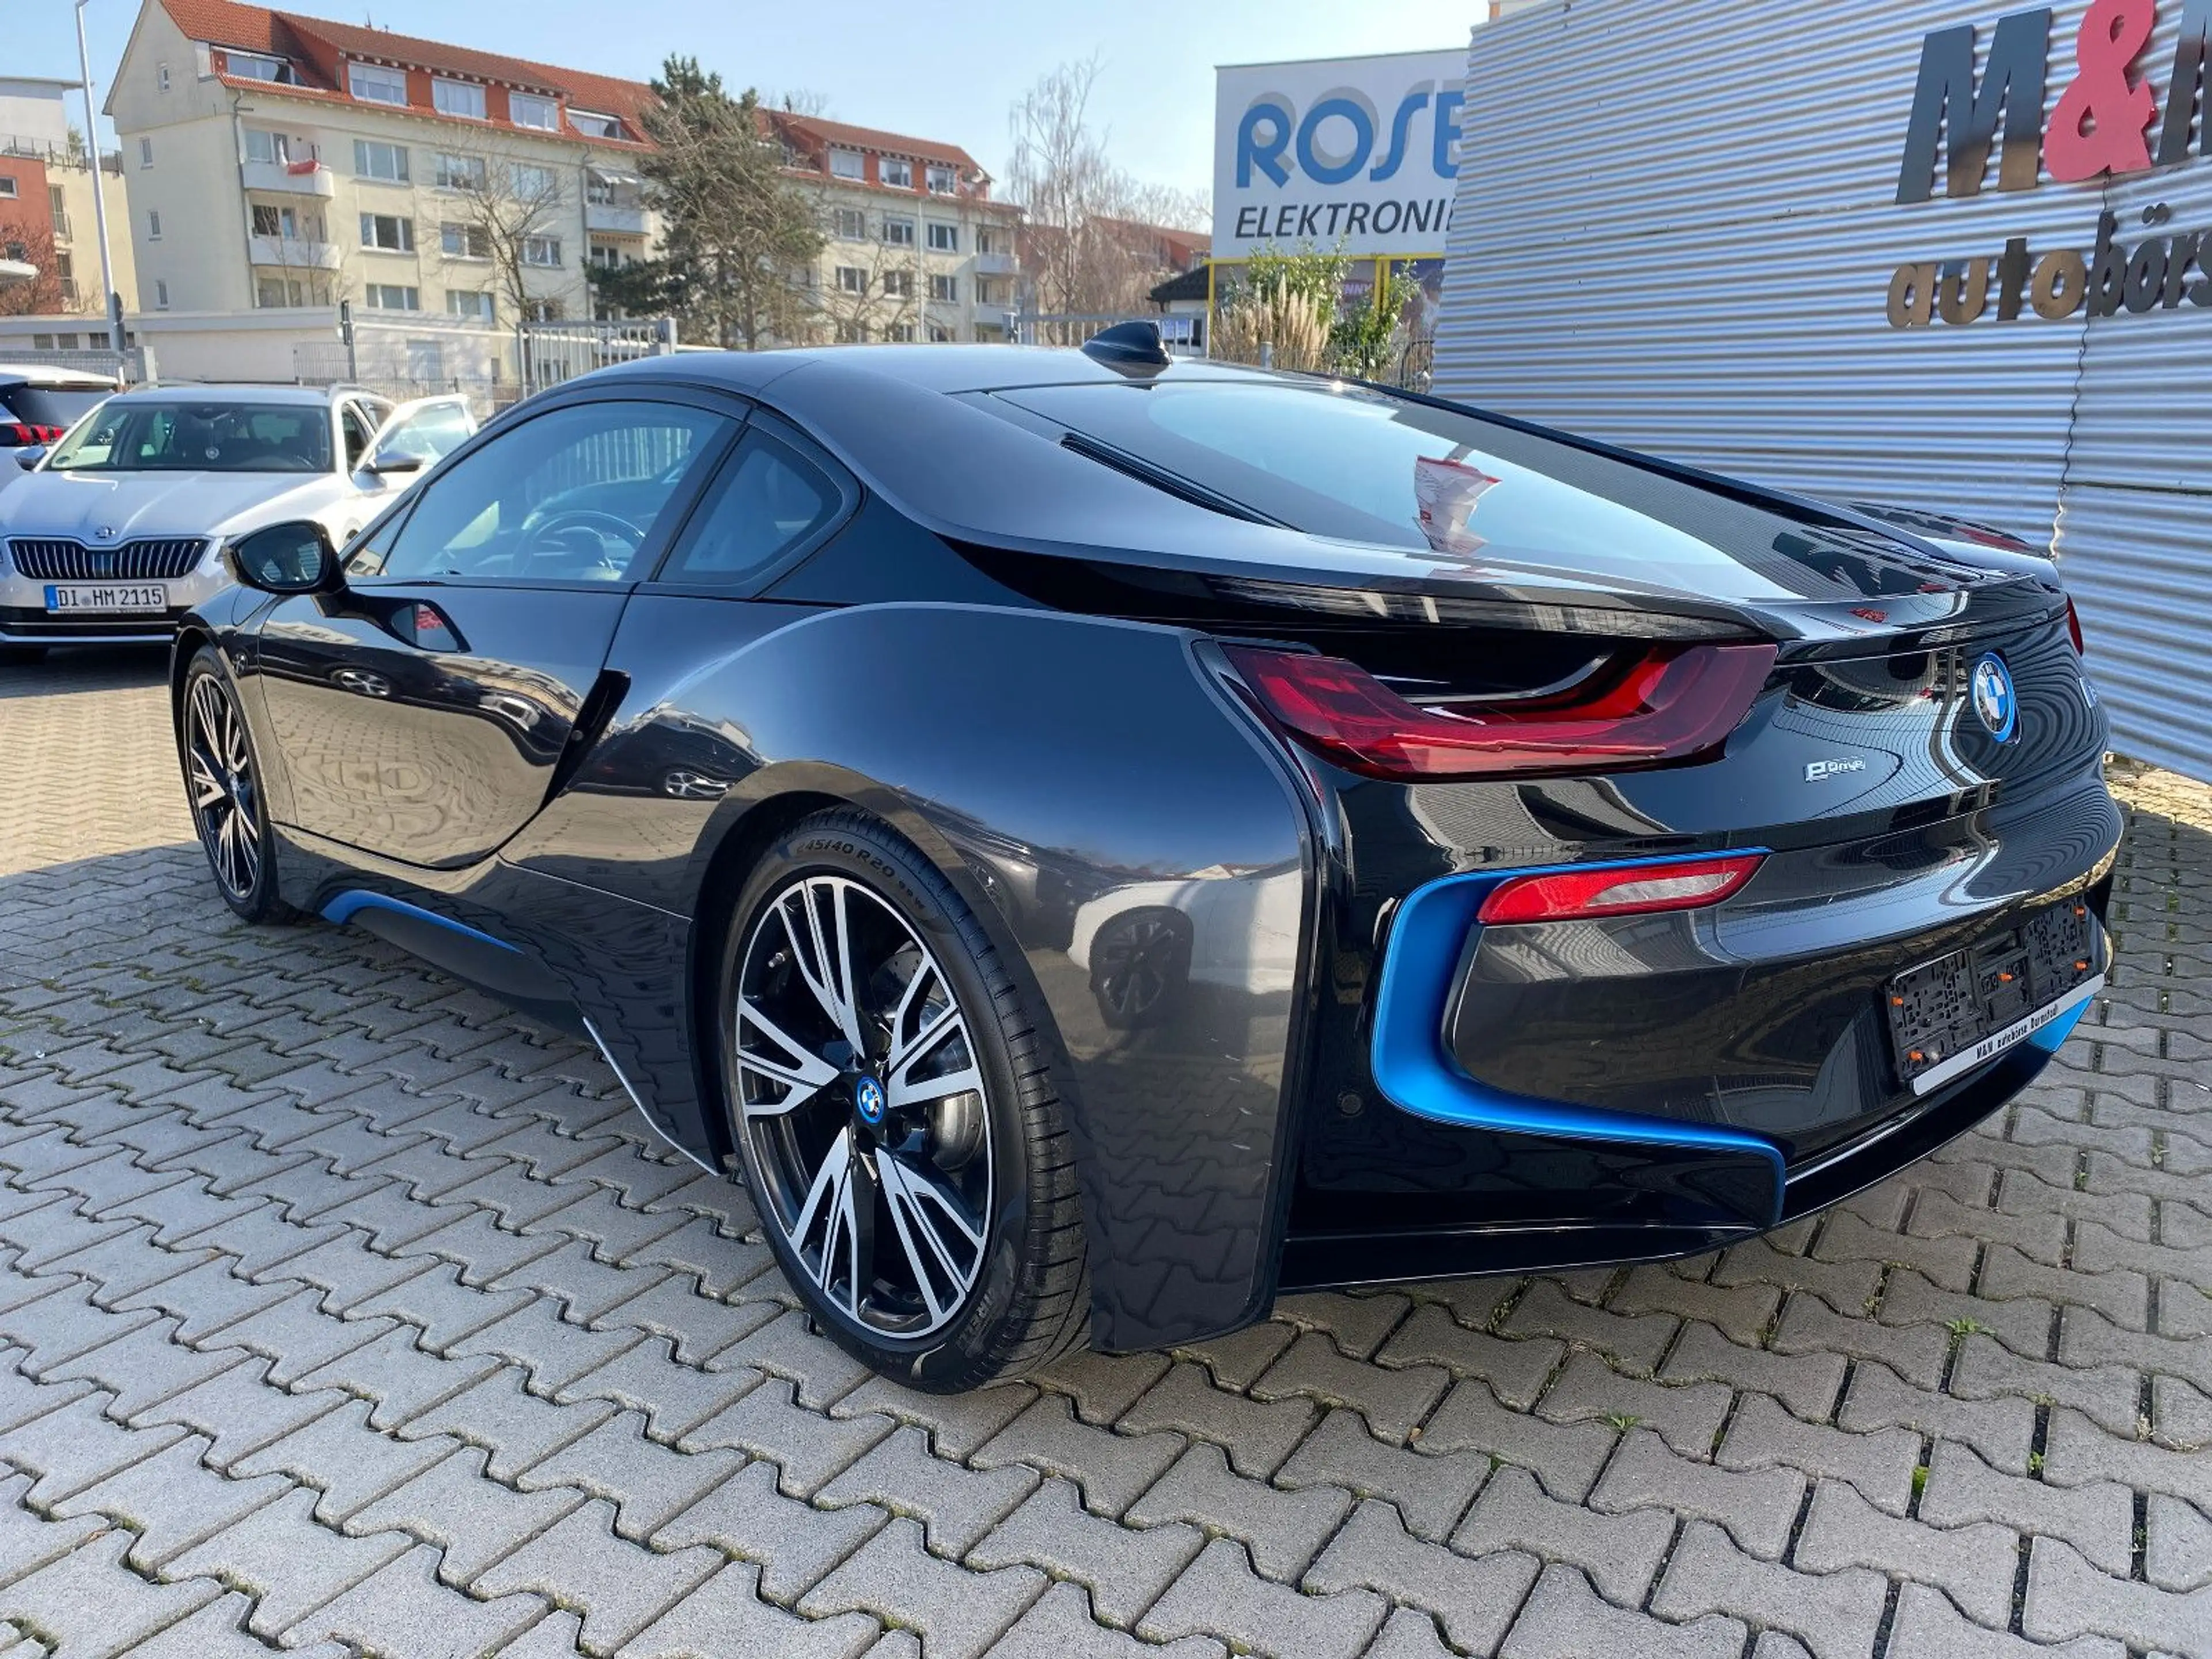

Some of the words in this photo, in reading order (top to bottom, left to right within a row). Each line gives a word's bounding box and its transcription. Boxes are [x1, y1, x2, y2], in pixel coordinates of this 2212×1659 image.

[1235, 197, 1456, 239] ELEKTRONI
[58, 589, 79, 607] DI
[92, 589, 116, 606] HM
[119, 588, 162, 605] 2115
